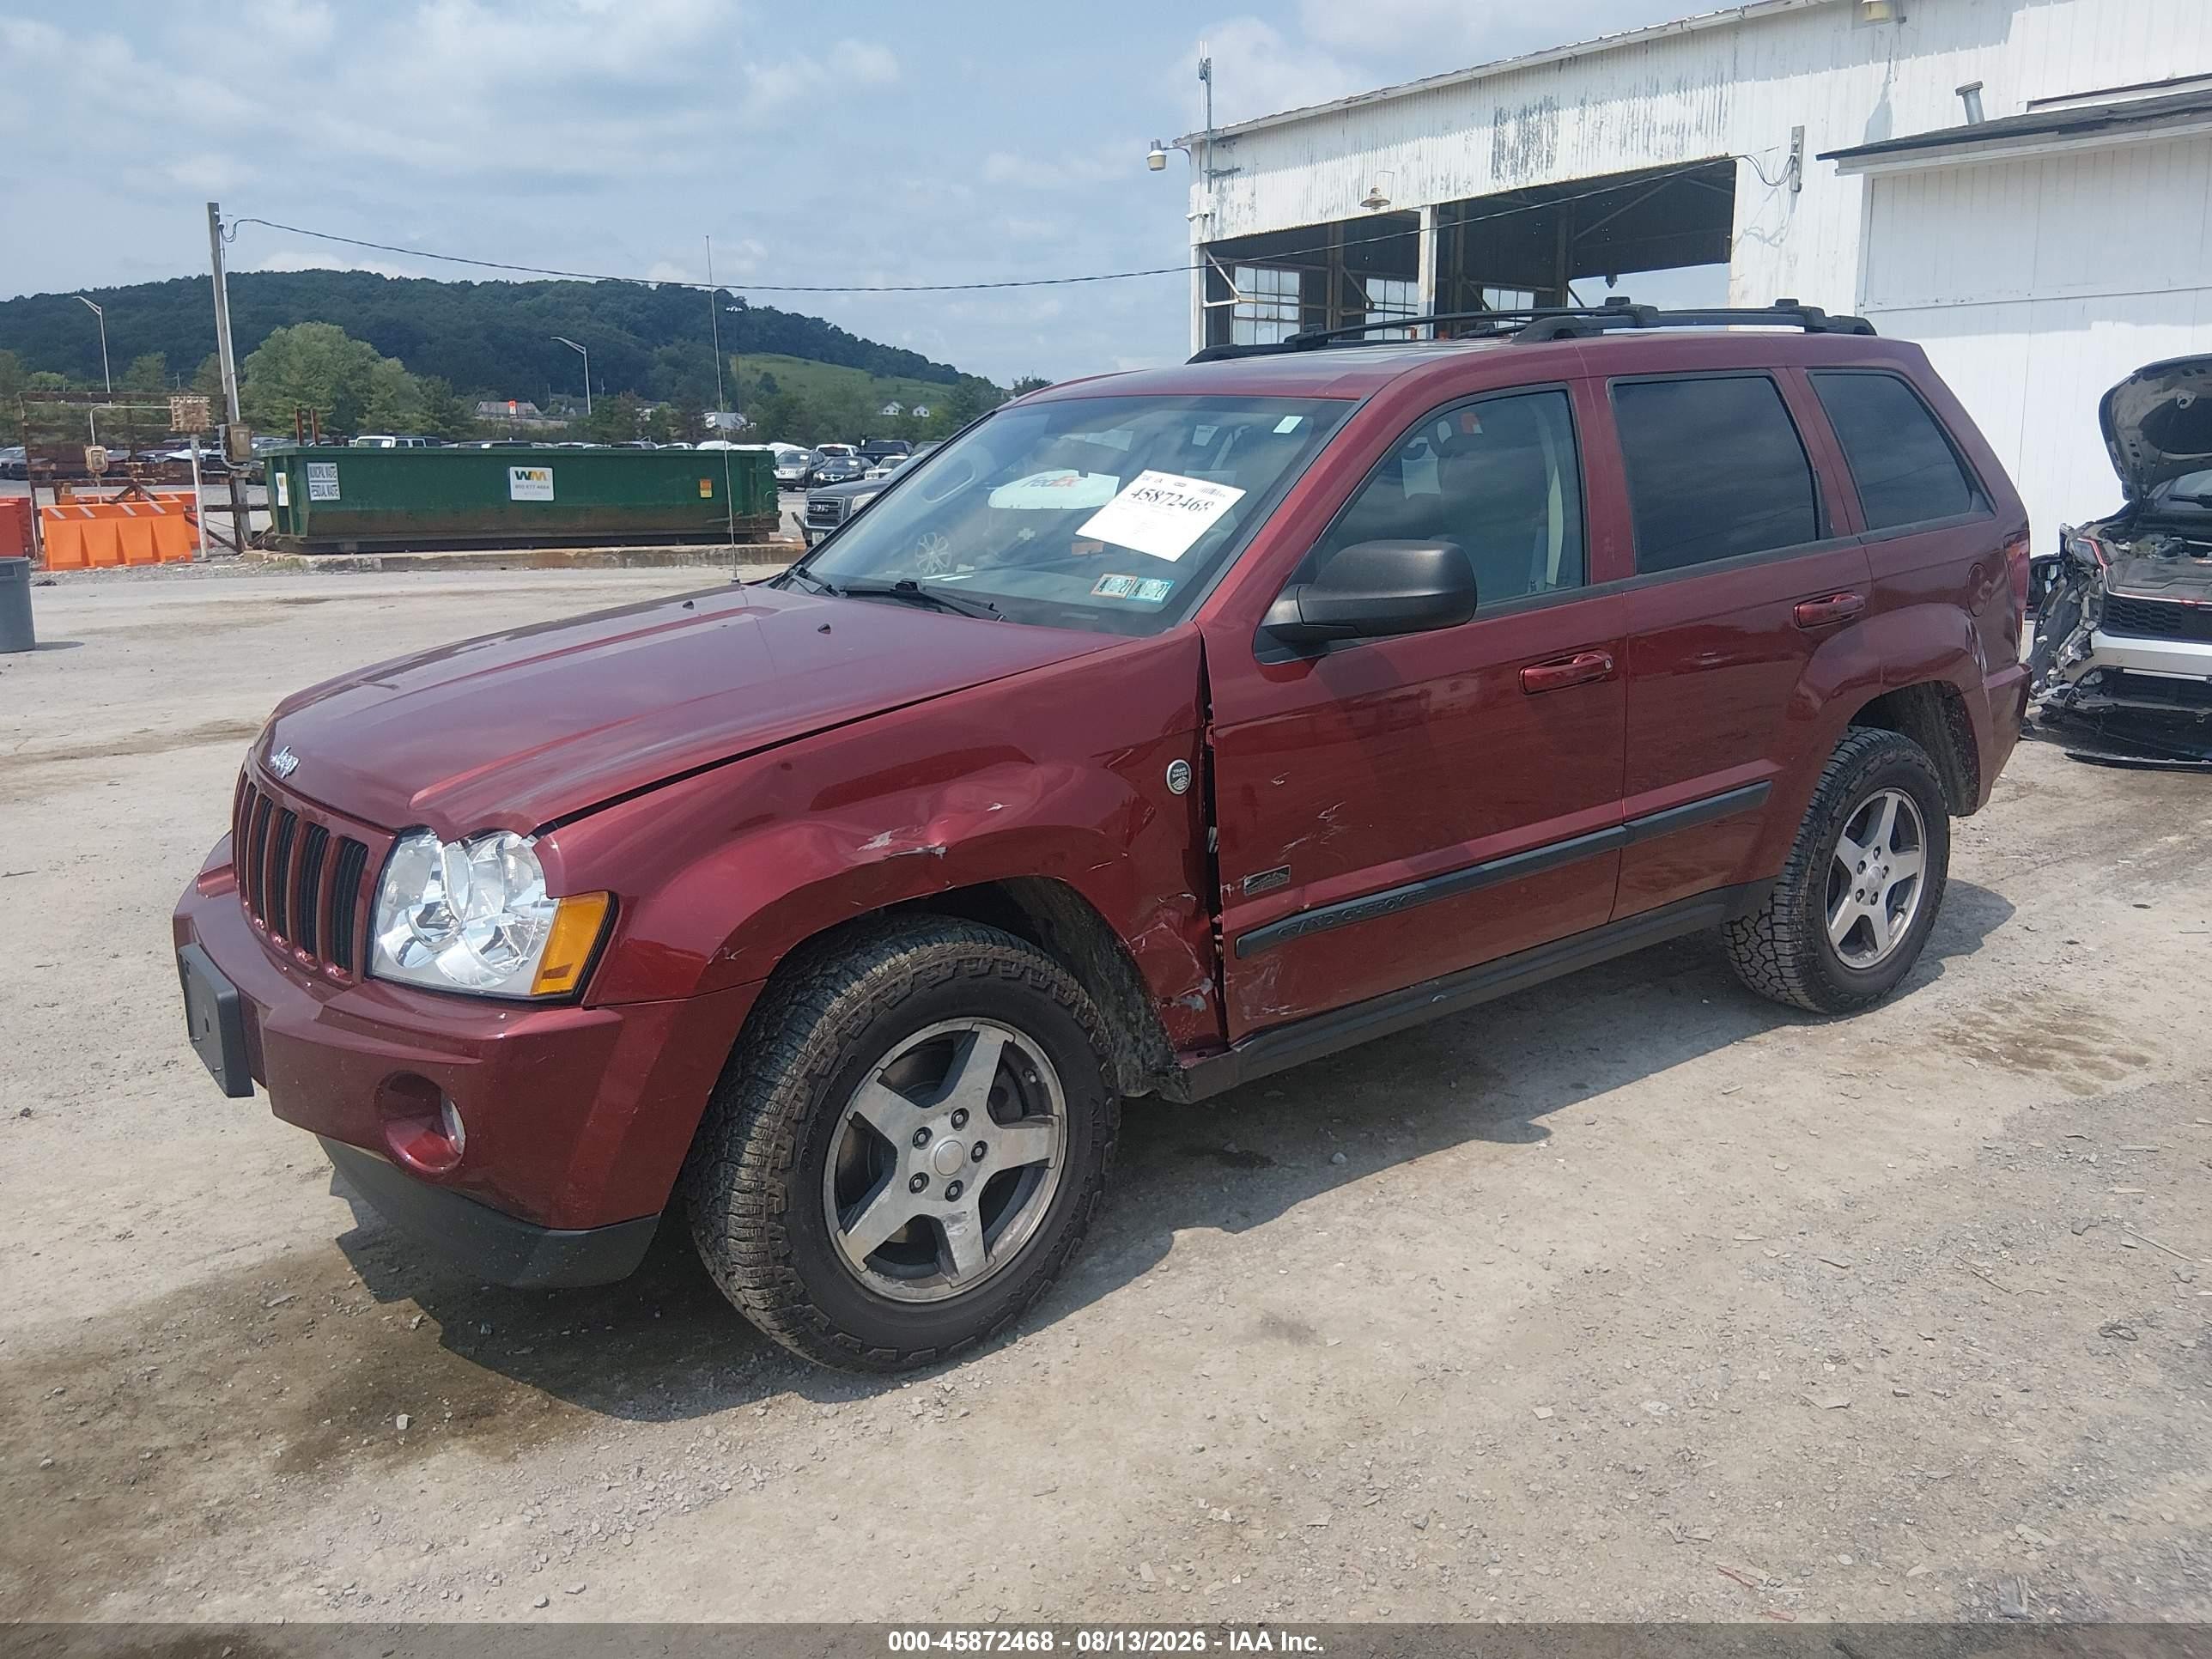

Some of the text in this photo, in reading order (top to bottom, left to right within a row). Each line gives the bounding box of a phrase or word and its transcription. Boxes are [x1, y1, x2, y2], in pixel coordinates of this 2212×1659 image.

[514, 470, 547, 481] WM
[1277, 890, 1427, 939] GRAND CHEROKEE
